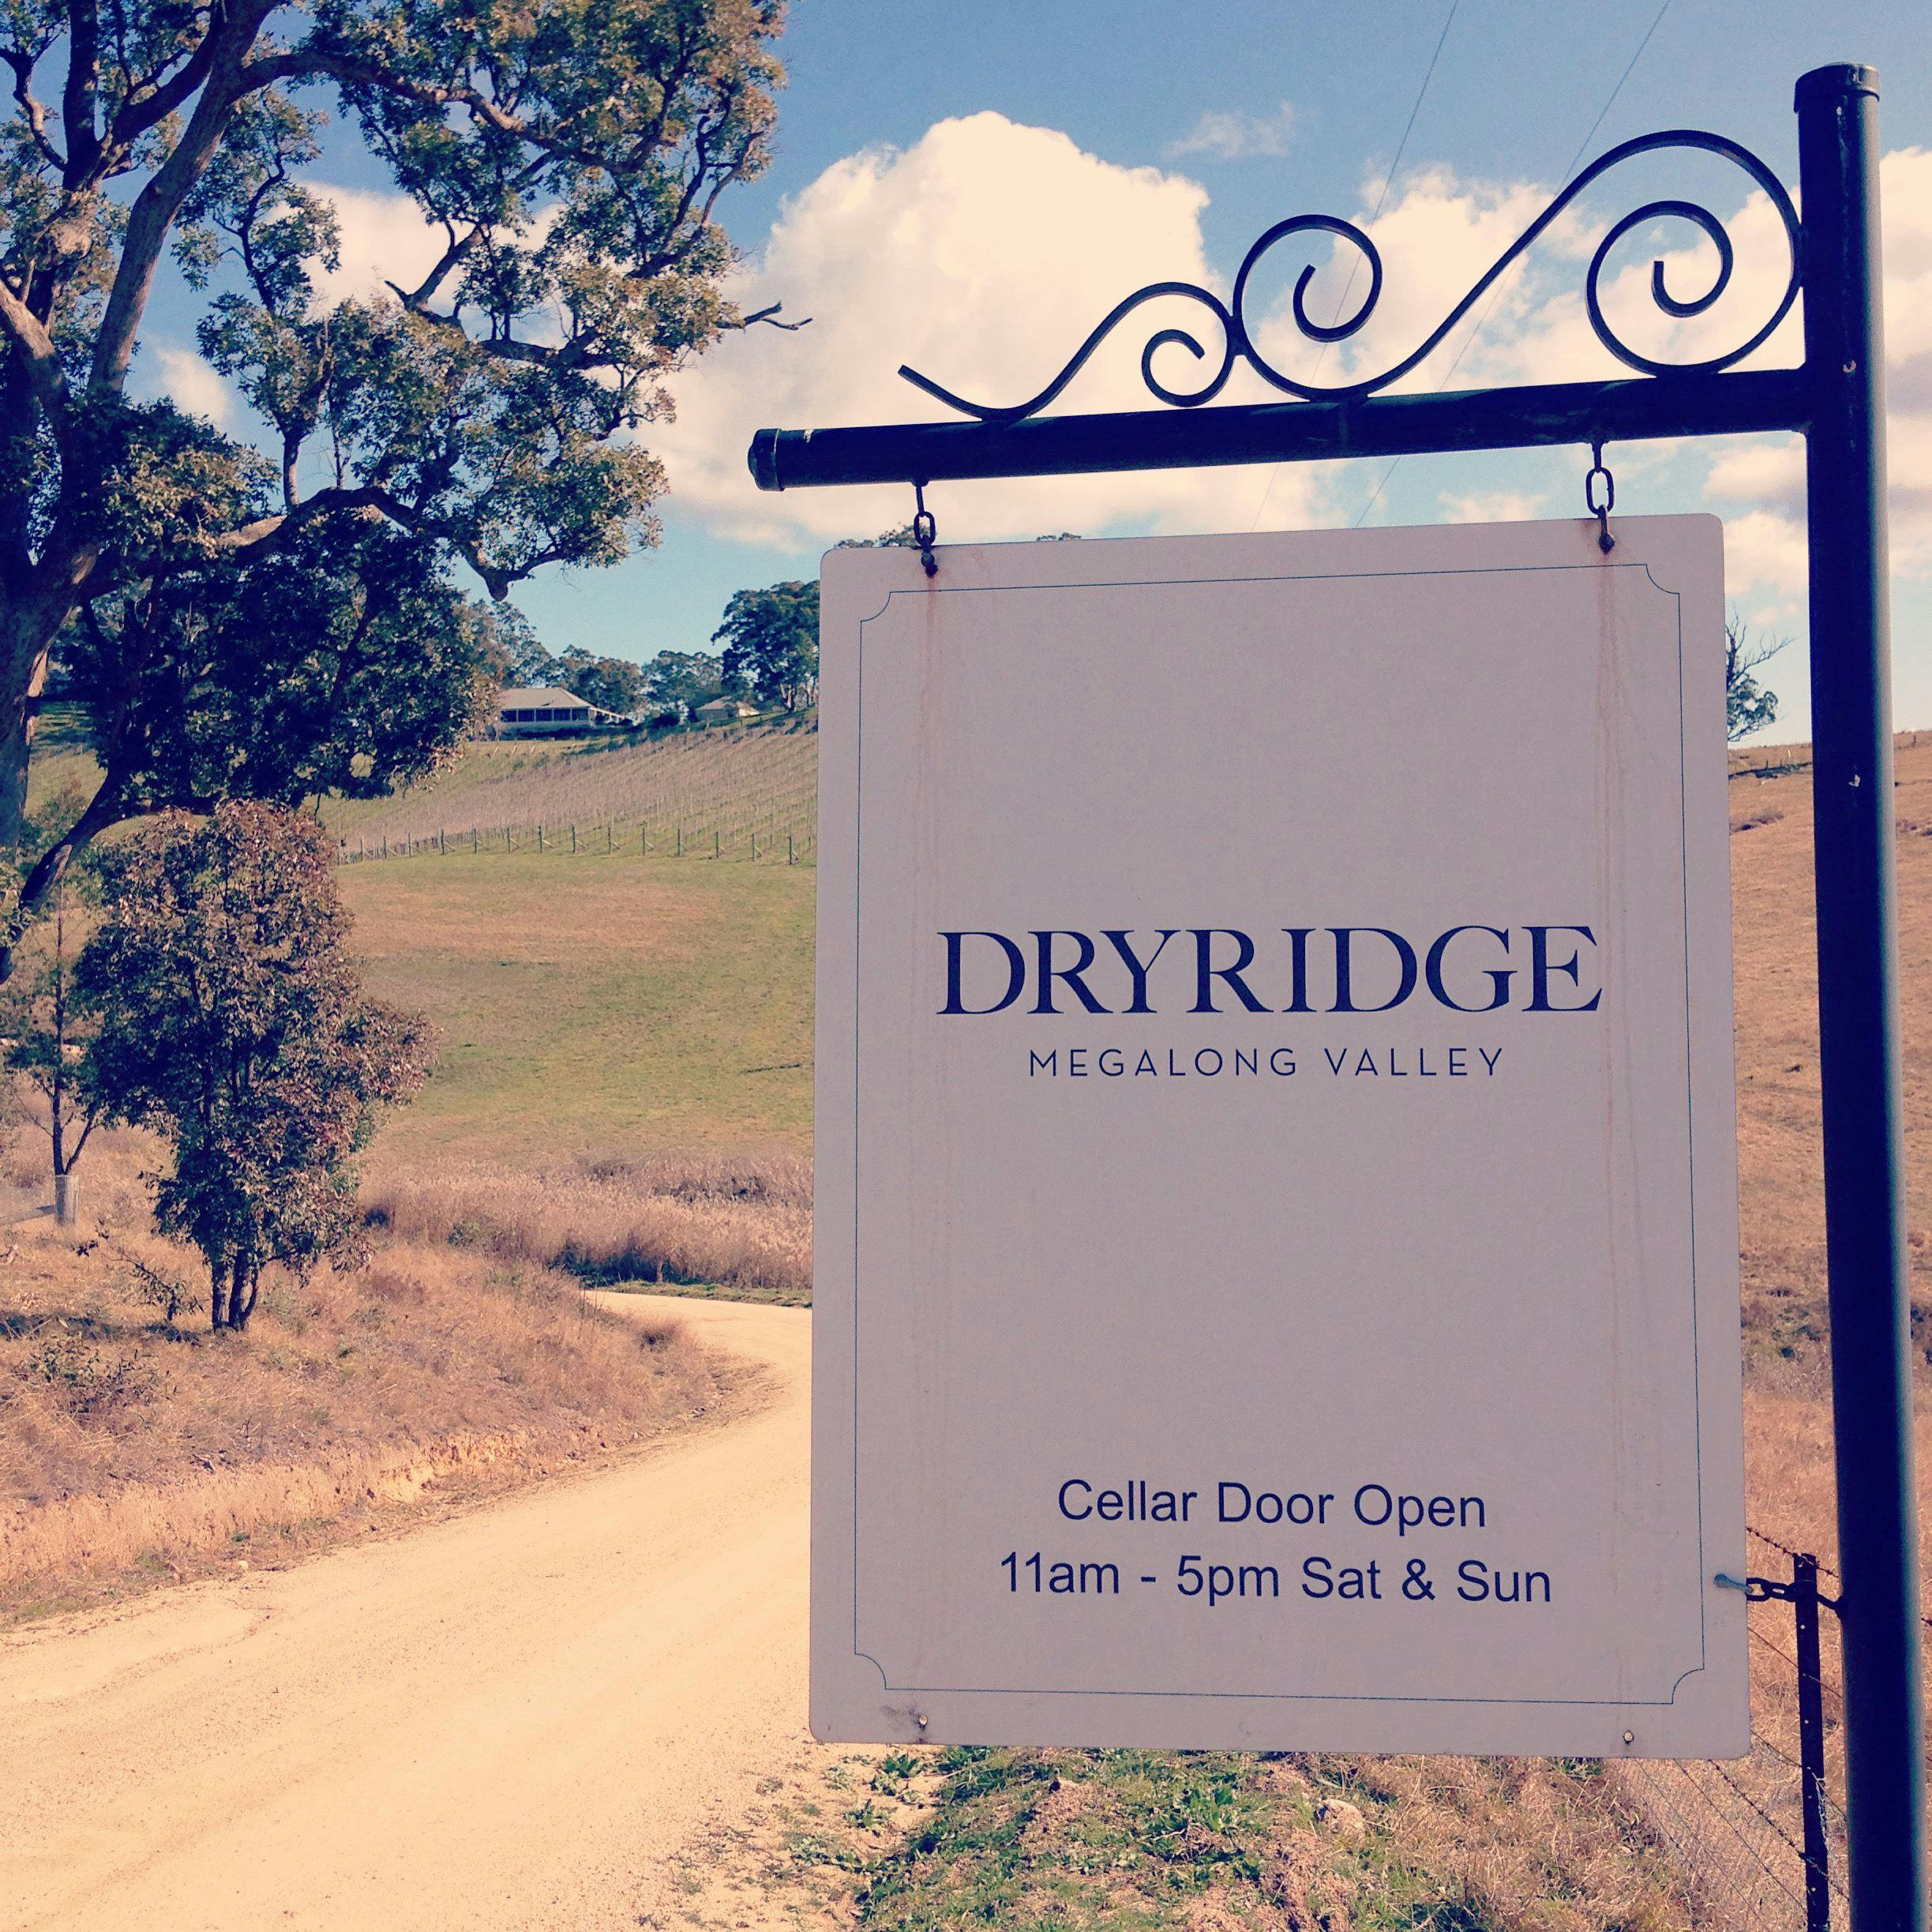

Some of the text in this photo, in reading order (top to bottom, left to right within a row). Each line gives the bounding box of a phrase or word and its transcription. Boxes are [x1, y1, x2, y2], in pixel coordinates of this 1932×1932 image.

[936, 925, 1603, 1015] DRYRIDGE
[1030, 1048, 1503, 1077] MEGALONG VALLEY
[1058, 1479, 1485, 1537] Cellar Door Open
[1000, 1551, 1120, 1594] 11am
[1176, 1555, 1280, 1607] 5pm
[1300, 1556, 1382, 1600] Sat
[1401, 1558, 1437, 1601] &
[1457, 1559, 1551, 1603] Sun
